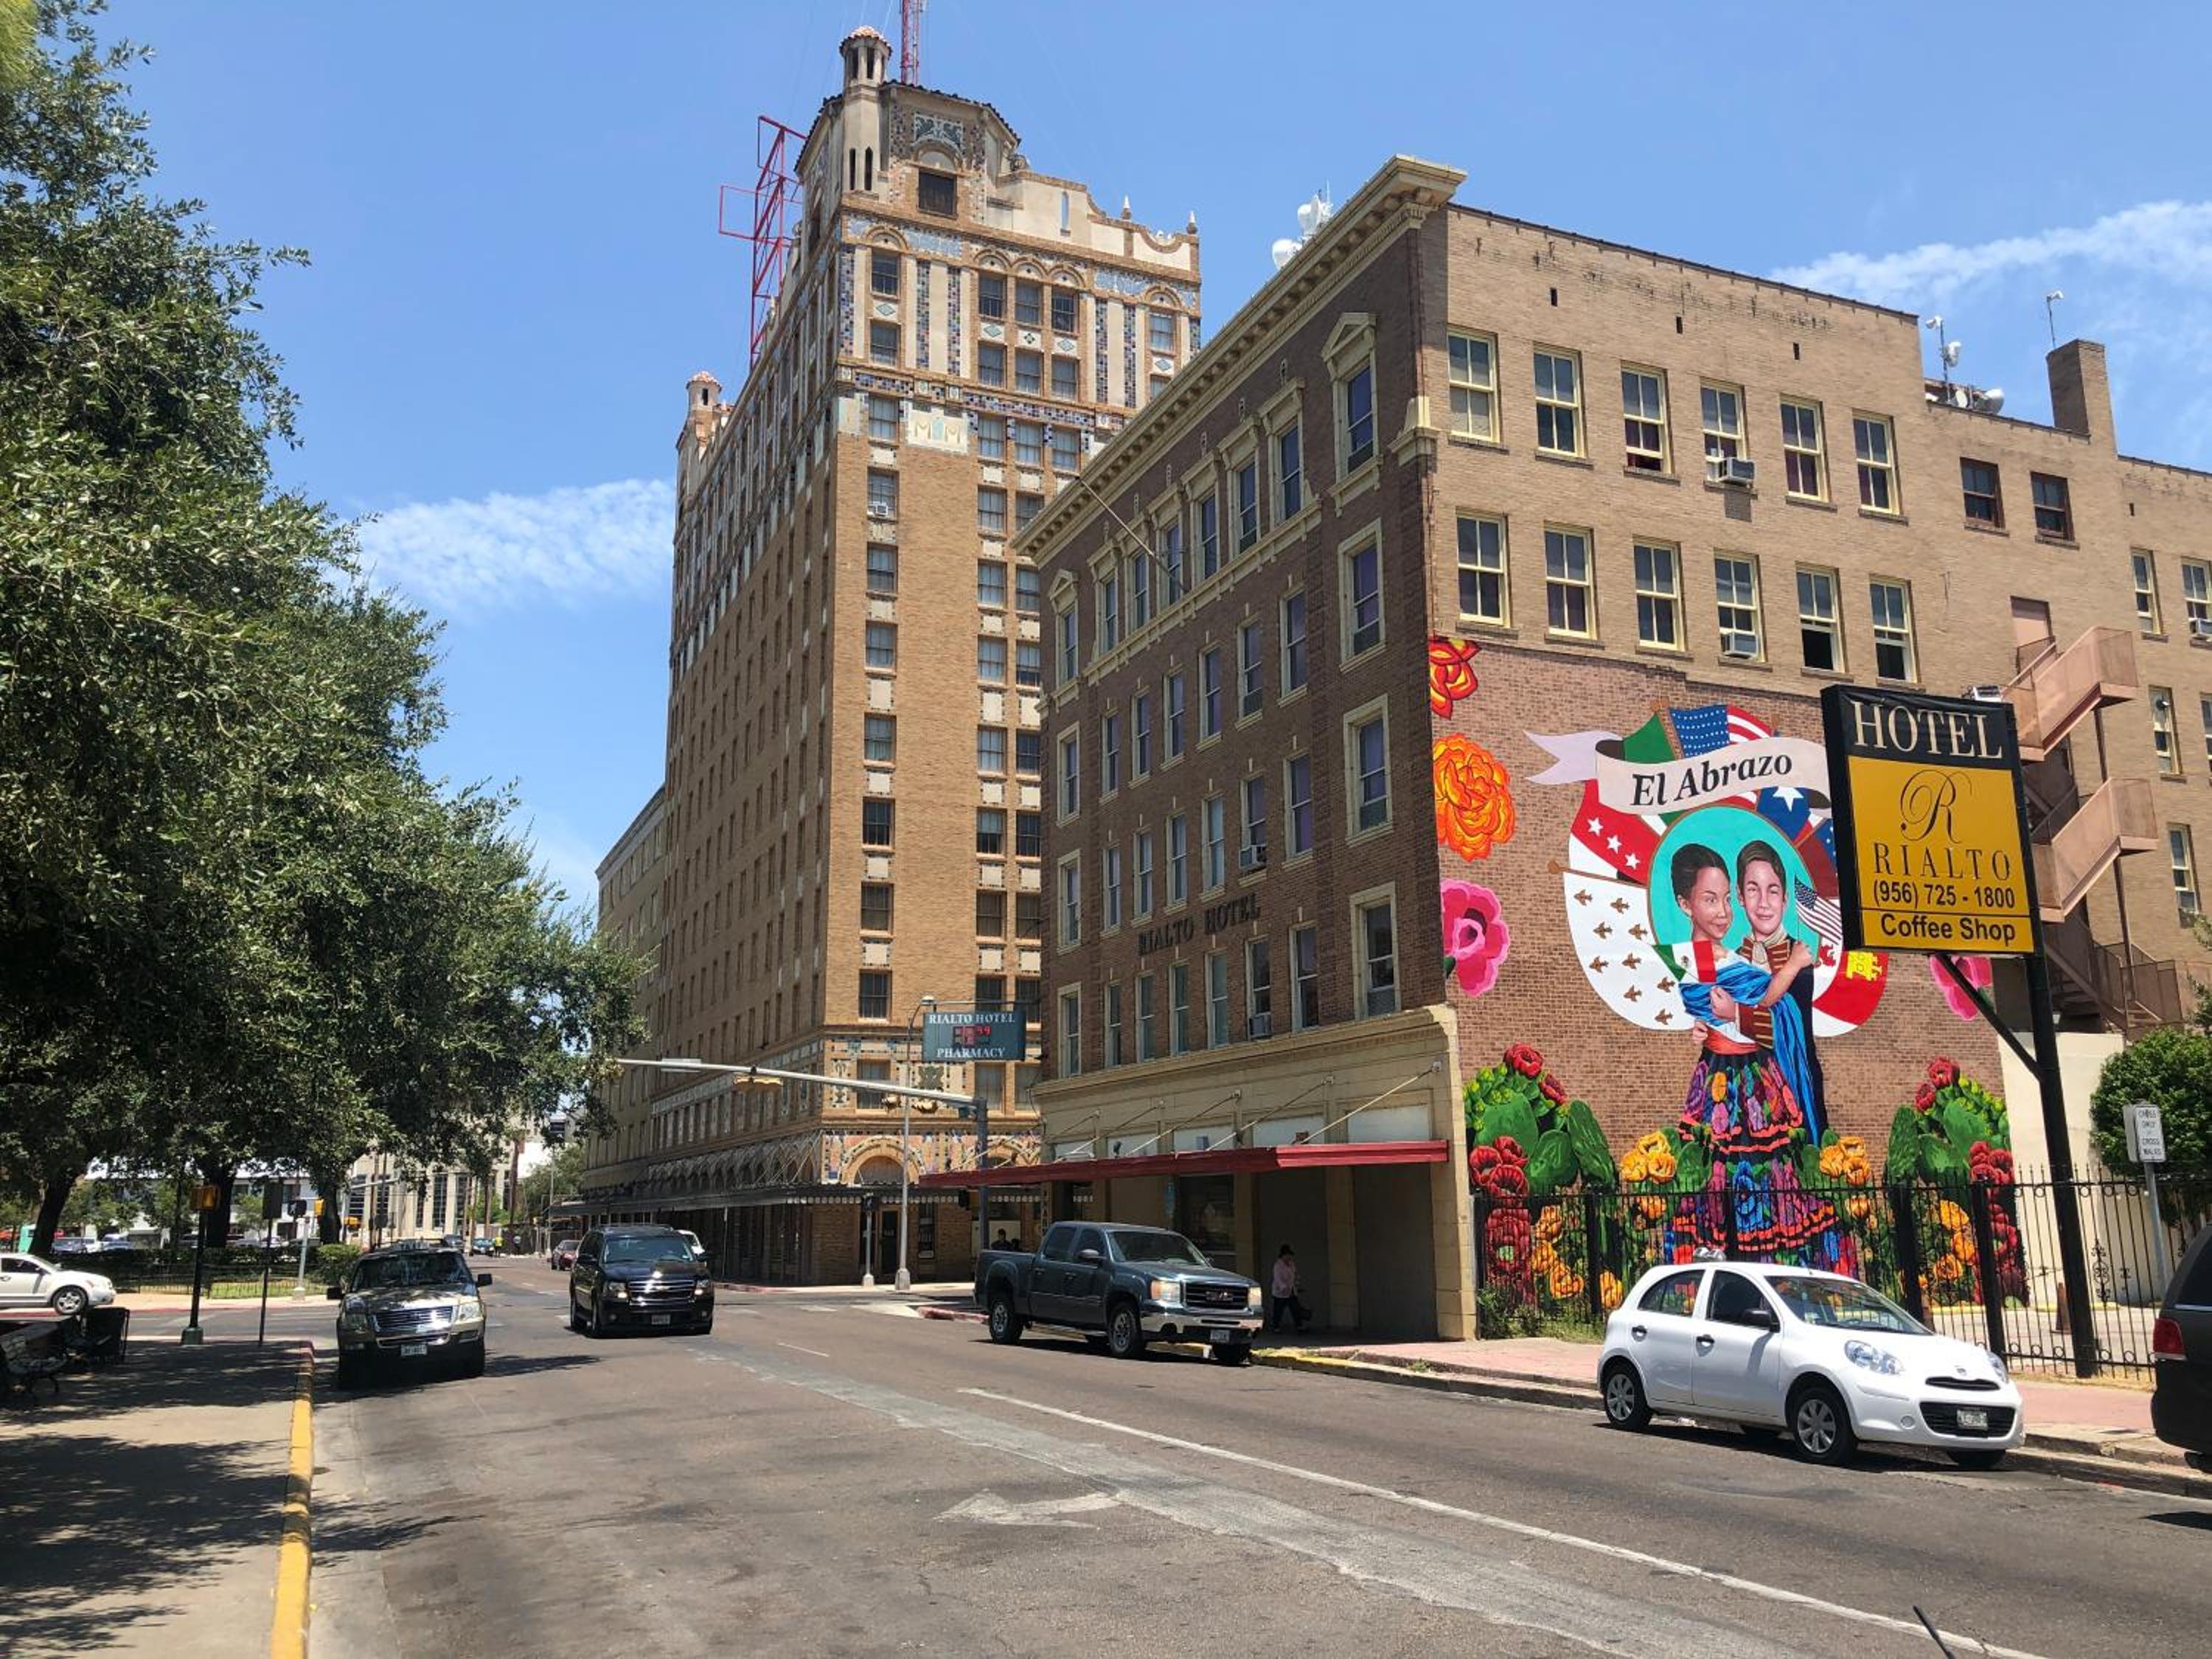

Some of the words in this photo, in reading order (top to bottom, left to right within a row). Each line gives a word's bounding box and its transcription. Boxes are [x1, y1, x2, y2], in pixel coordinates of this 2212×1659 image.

[1850, 700, 2003, 759] HOTEL
[1630, 772, 1668, 806] El
[1674, 754, 1792, 801] Abrazo
[1900, 769, 1972, 844] R
[1874, 843, 2010, 881] RIALTO
[1874, 879, 1919, 908] (956)
[1924, 883, 1956, 905] 725
[1974, 886, 2015, 908] 1800
[1139, 918, 1194, 956] RIALTO
[1205, 893, 1260, 934] HOTEL
[1881, 913, 1952, 939] Coffee
[1960, 917, 2015, 946] Shop
[928, 1013, 973, 1024] RIALTO
[975, 1013, 1015, 1023] HOTEL
[936, 1048, 1005, 1058] PHARMACY
